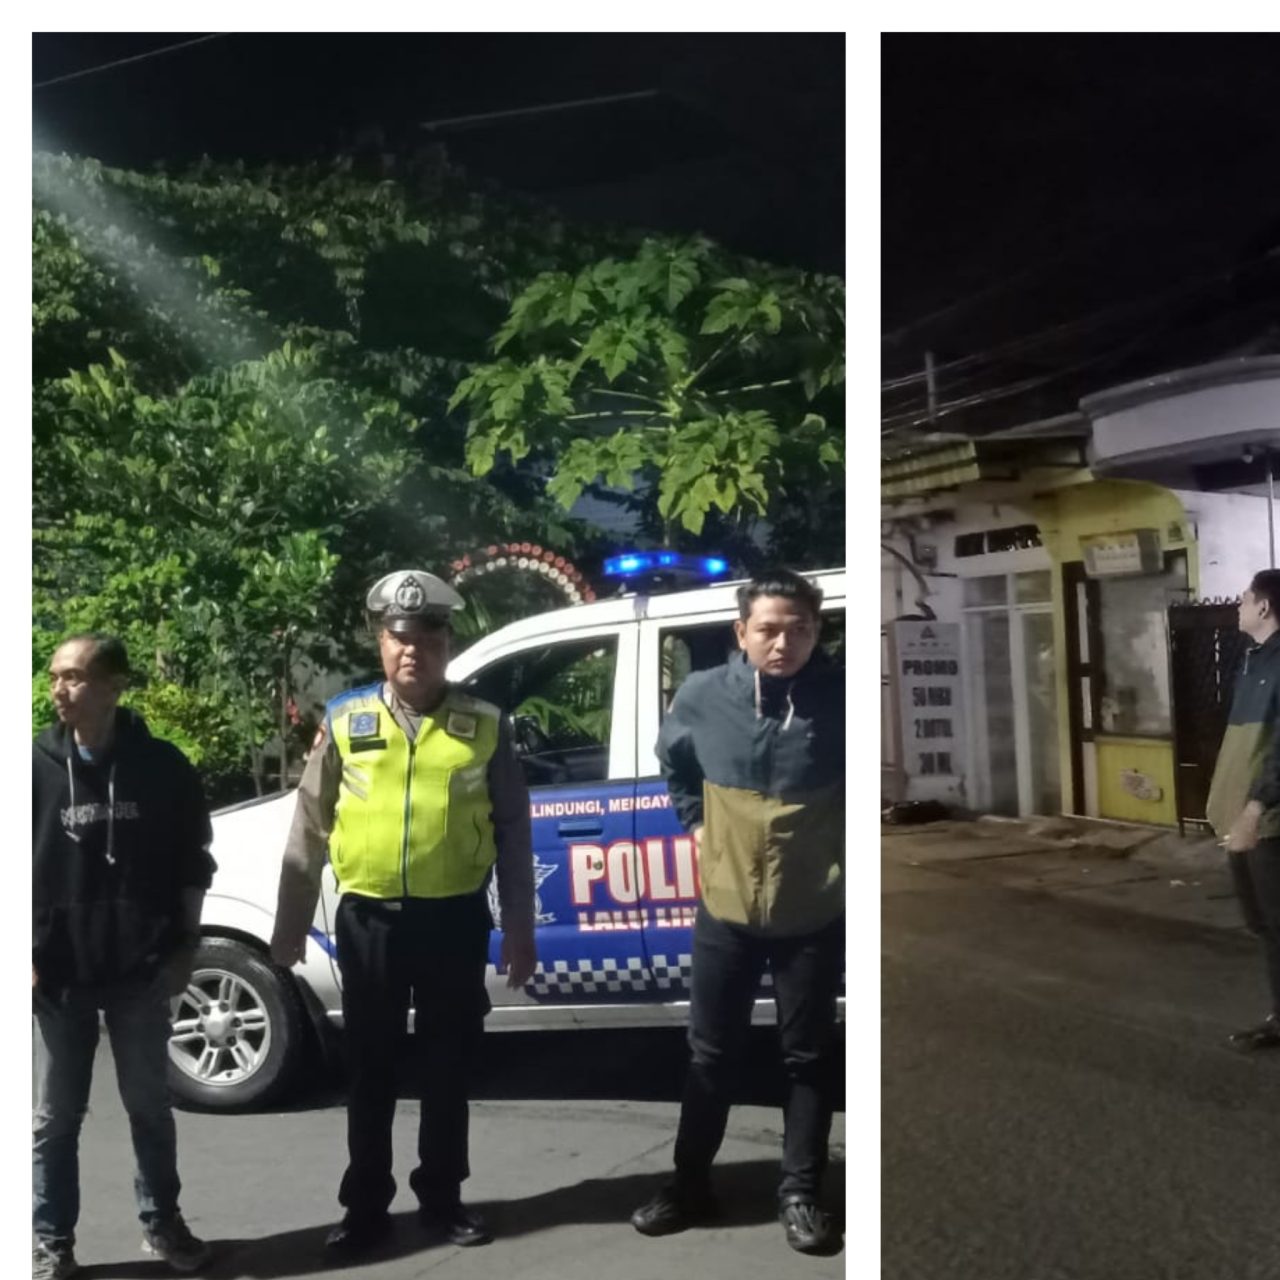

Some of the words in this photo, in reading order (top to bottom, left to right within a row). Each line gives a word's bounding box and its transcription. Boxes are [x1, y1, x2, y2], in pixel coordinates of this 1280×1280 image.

[608, 794, 673, 813] MENGAY
[571, 836, 699, 905] POLI
[578, 908, 649, 932] LALU
[656, 906, 698, 929] LIN
